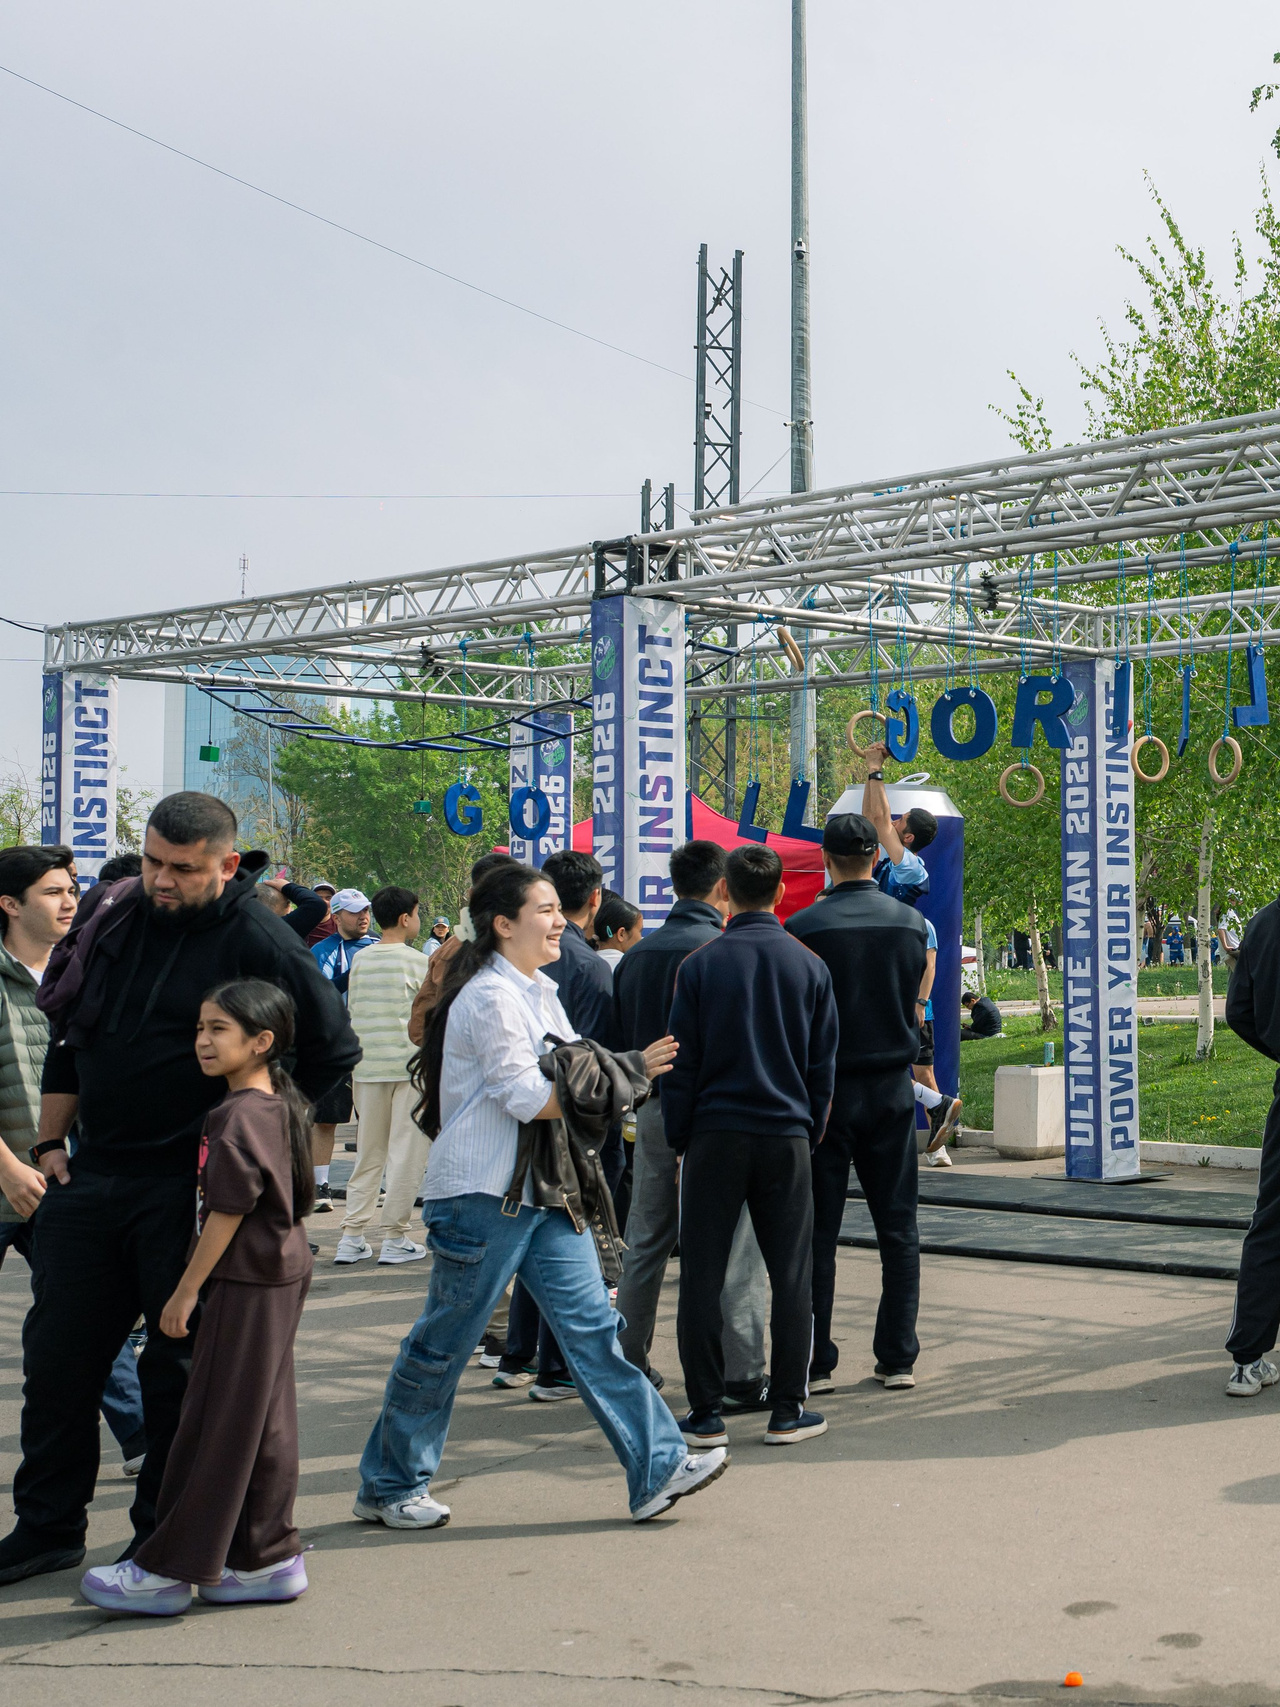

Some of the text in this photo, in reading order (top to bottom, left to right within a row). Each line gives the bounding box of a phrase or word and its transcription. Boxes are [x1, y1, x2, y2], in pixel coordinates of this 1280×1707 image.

[43, 732, 56, 827] 2026
[72, 679, 109, 858] INSTINCT
[593, 691, 615, 814] 2026
[639, 624, 673, 853] INSTINCT
[1066, 735, 1089, 834] 2026
[1066, 851, 1091, 939] MAN
[1107, 882, 1132, 991] YOUR
[1068, 956, 1094, 1147] ULTIMATE
[1109, 1006, 1135, 1151] POWER
